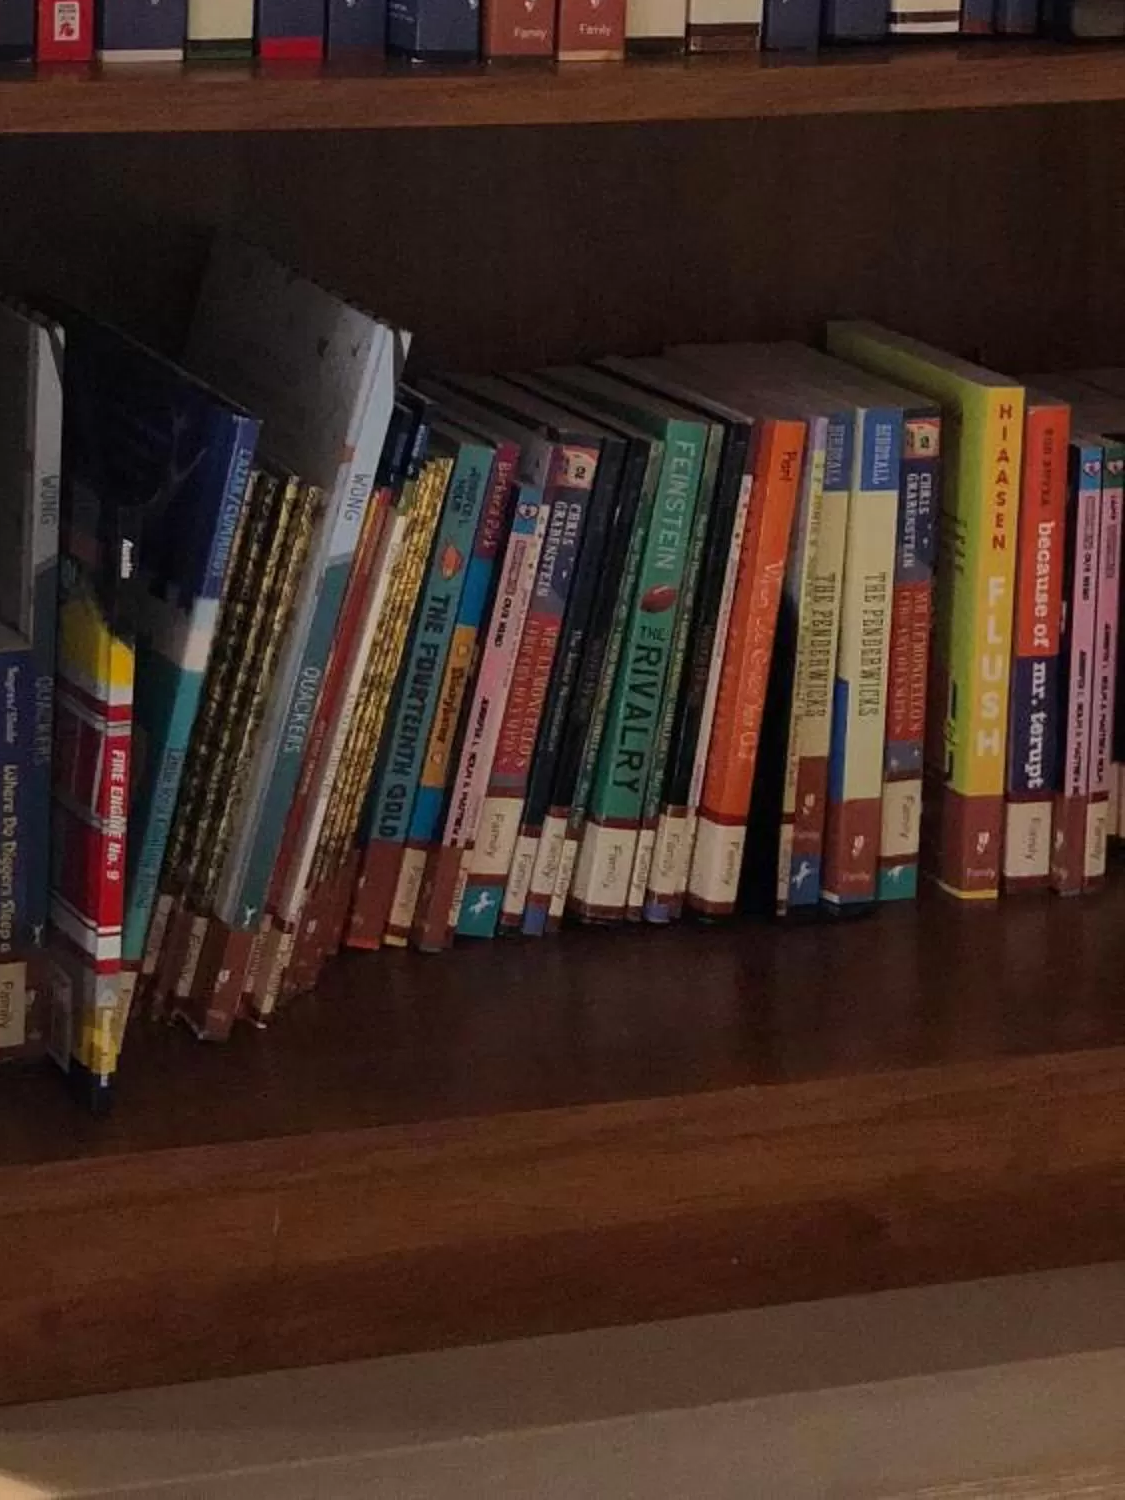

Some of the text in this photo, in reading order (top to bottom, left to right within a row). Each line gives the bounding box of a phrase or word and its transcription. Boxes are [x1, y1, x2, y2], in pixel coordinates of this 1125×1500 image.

[39, 474, 59, 526] WONG
[342, 472, 372, 522] WONG
[871, 423, 892, 485] BIRDSALL
[918, 472, 932, 516] CHRIS
[991, 403, 1013, 550] HIAASEN
[536, 500, 566, 598] GRABENSTEIN
[562, 502, 582, 545] CHRIS
[654, 439, 696, 570] FEINSTEIN
[902, 472, 918, 569] GRABENSTEIN
[425, 594, 451, 634] THE
[1033, 521, 1056, 649] because of
[805, 572, 836, 718] THE PENDERWICKS
[858, 571, 887, 717] THE PENDERWICKS
[976, 574, 1006, 757] FLUSH
[282, 666, 321, 754] QUACKERS
[393, 642, 441, 777] FOURTEENTH
[611, 643, 664, 794] RIVALRY
[1024, 661, 1048, 790] mr. terupt
[1, 763, 19, 813] Where
[1, 816, 18, 837] Do
[106, 749, 126, 882] FIRE ENGINE No. 9
[487, 812, 505, 859] Family
